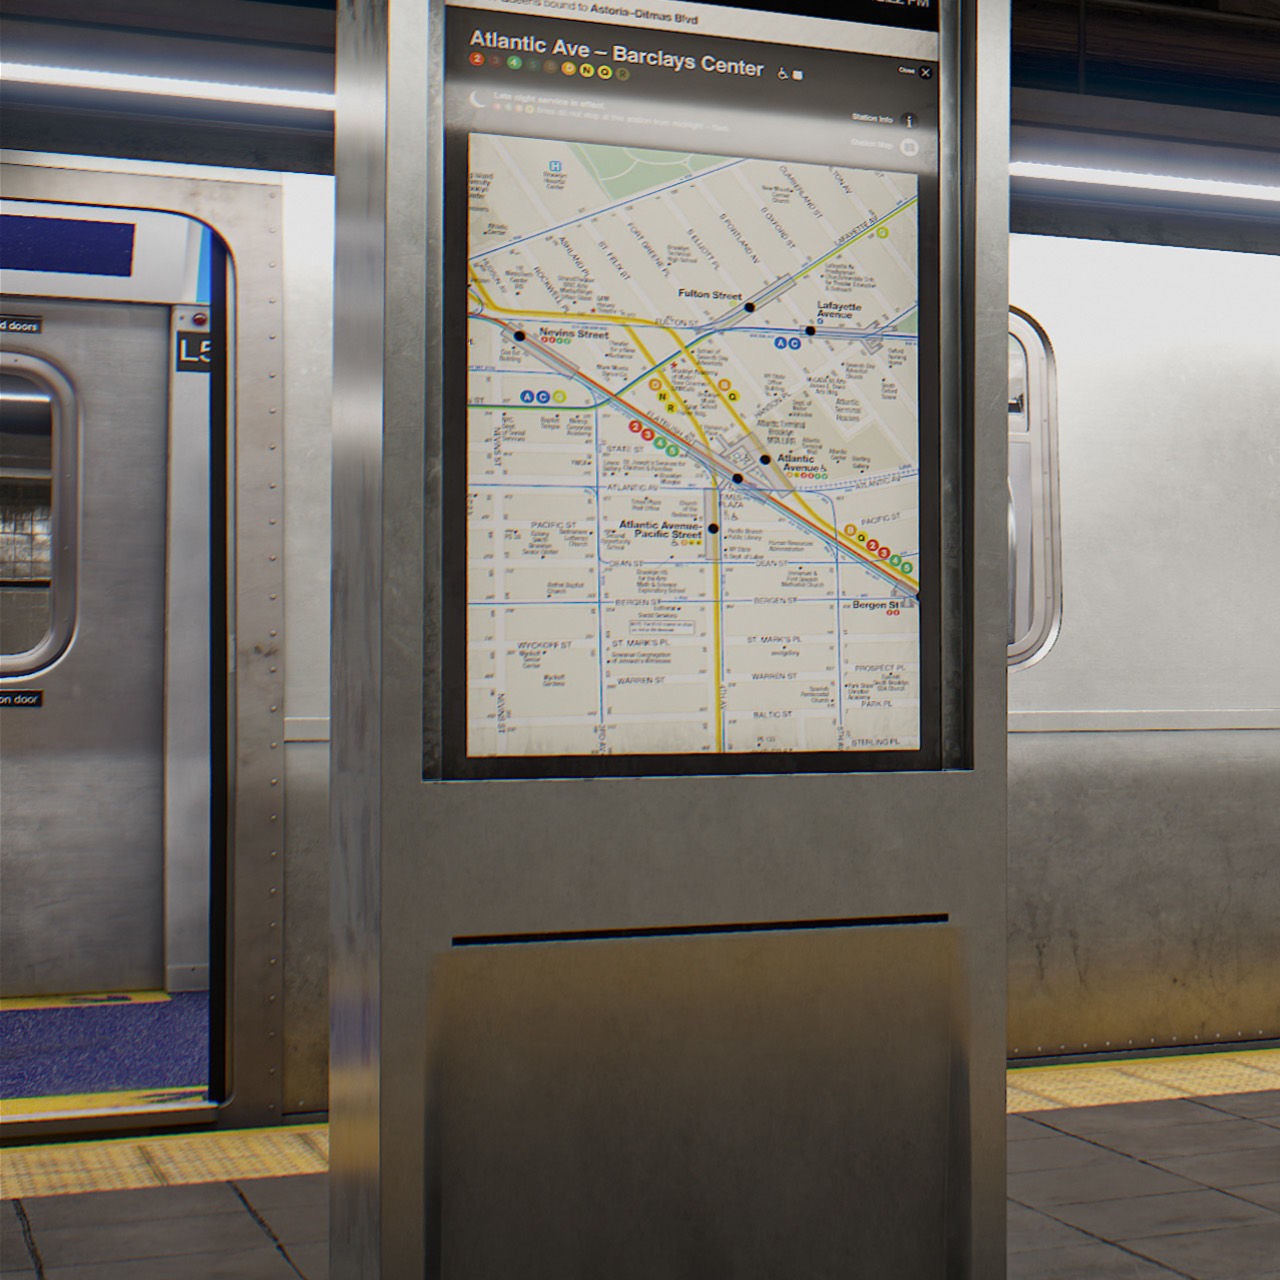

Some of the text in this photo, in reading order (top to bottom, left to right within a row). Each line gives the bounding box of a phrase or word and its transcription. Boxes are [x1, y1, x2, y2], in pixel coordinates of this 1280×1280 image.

[578, 2, 590, 13] to
[674, 13, 700, 25] Blvd
[469, 30, 765, 77] Atlantic Ave Barclays Center
[678, 288, 744, 301] Fulton Street
[817, 300, 863, 312] Lafayette
[817, 310, 854, 320] Avenue
[8, 320, 39, 331] doors
[538, 327, 610, 341] Nevins Street
[777, 453, 815, 464] Atlantic
[783, 463, 819, 472] Avenue
[619, 519, 660, 530] Atlantic
[634, 529, 703, 540] Pacific Street
[852, 600, 899, 611] Bergen St
[13, 694, 40, 705] door
